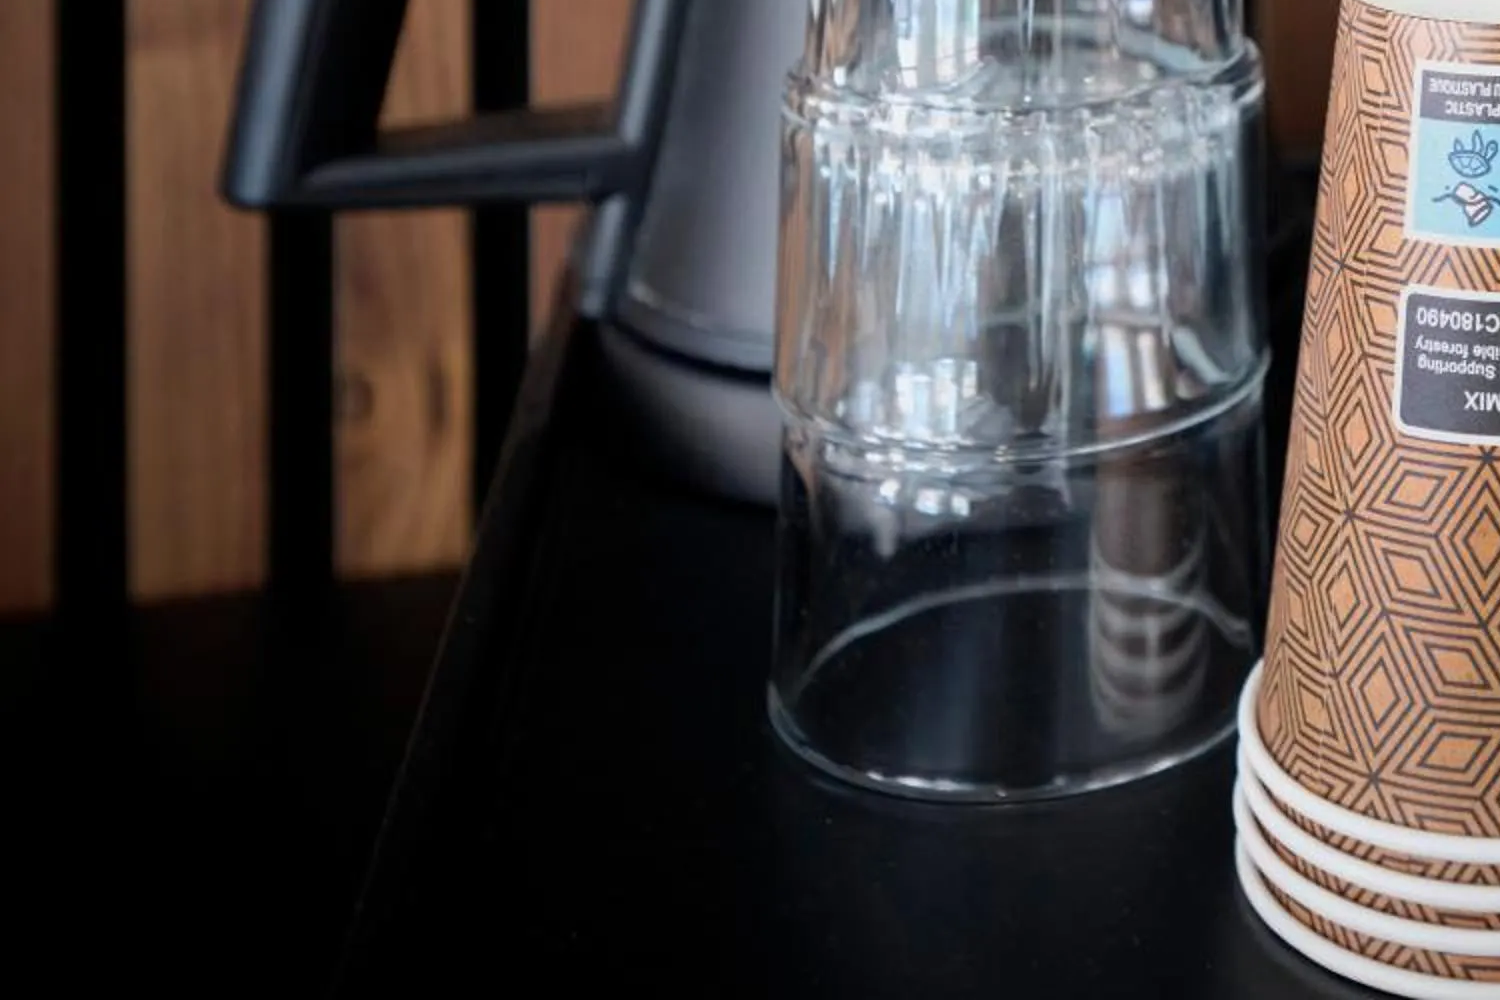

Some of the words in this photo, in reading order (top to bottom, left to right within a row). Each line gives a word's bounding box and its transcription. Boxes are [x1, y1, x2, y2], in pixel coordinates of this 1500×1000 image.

[1429, 78, 1492, 97] PLASTIQUE
[1444, 100, 1500, 116] PLASTIC
[1416, 307, 1500, 332] C180490
[1414, 336, 1469, 358] forestry
[1417, 354, 1497, 378] Supporting
